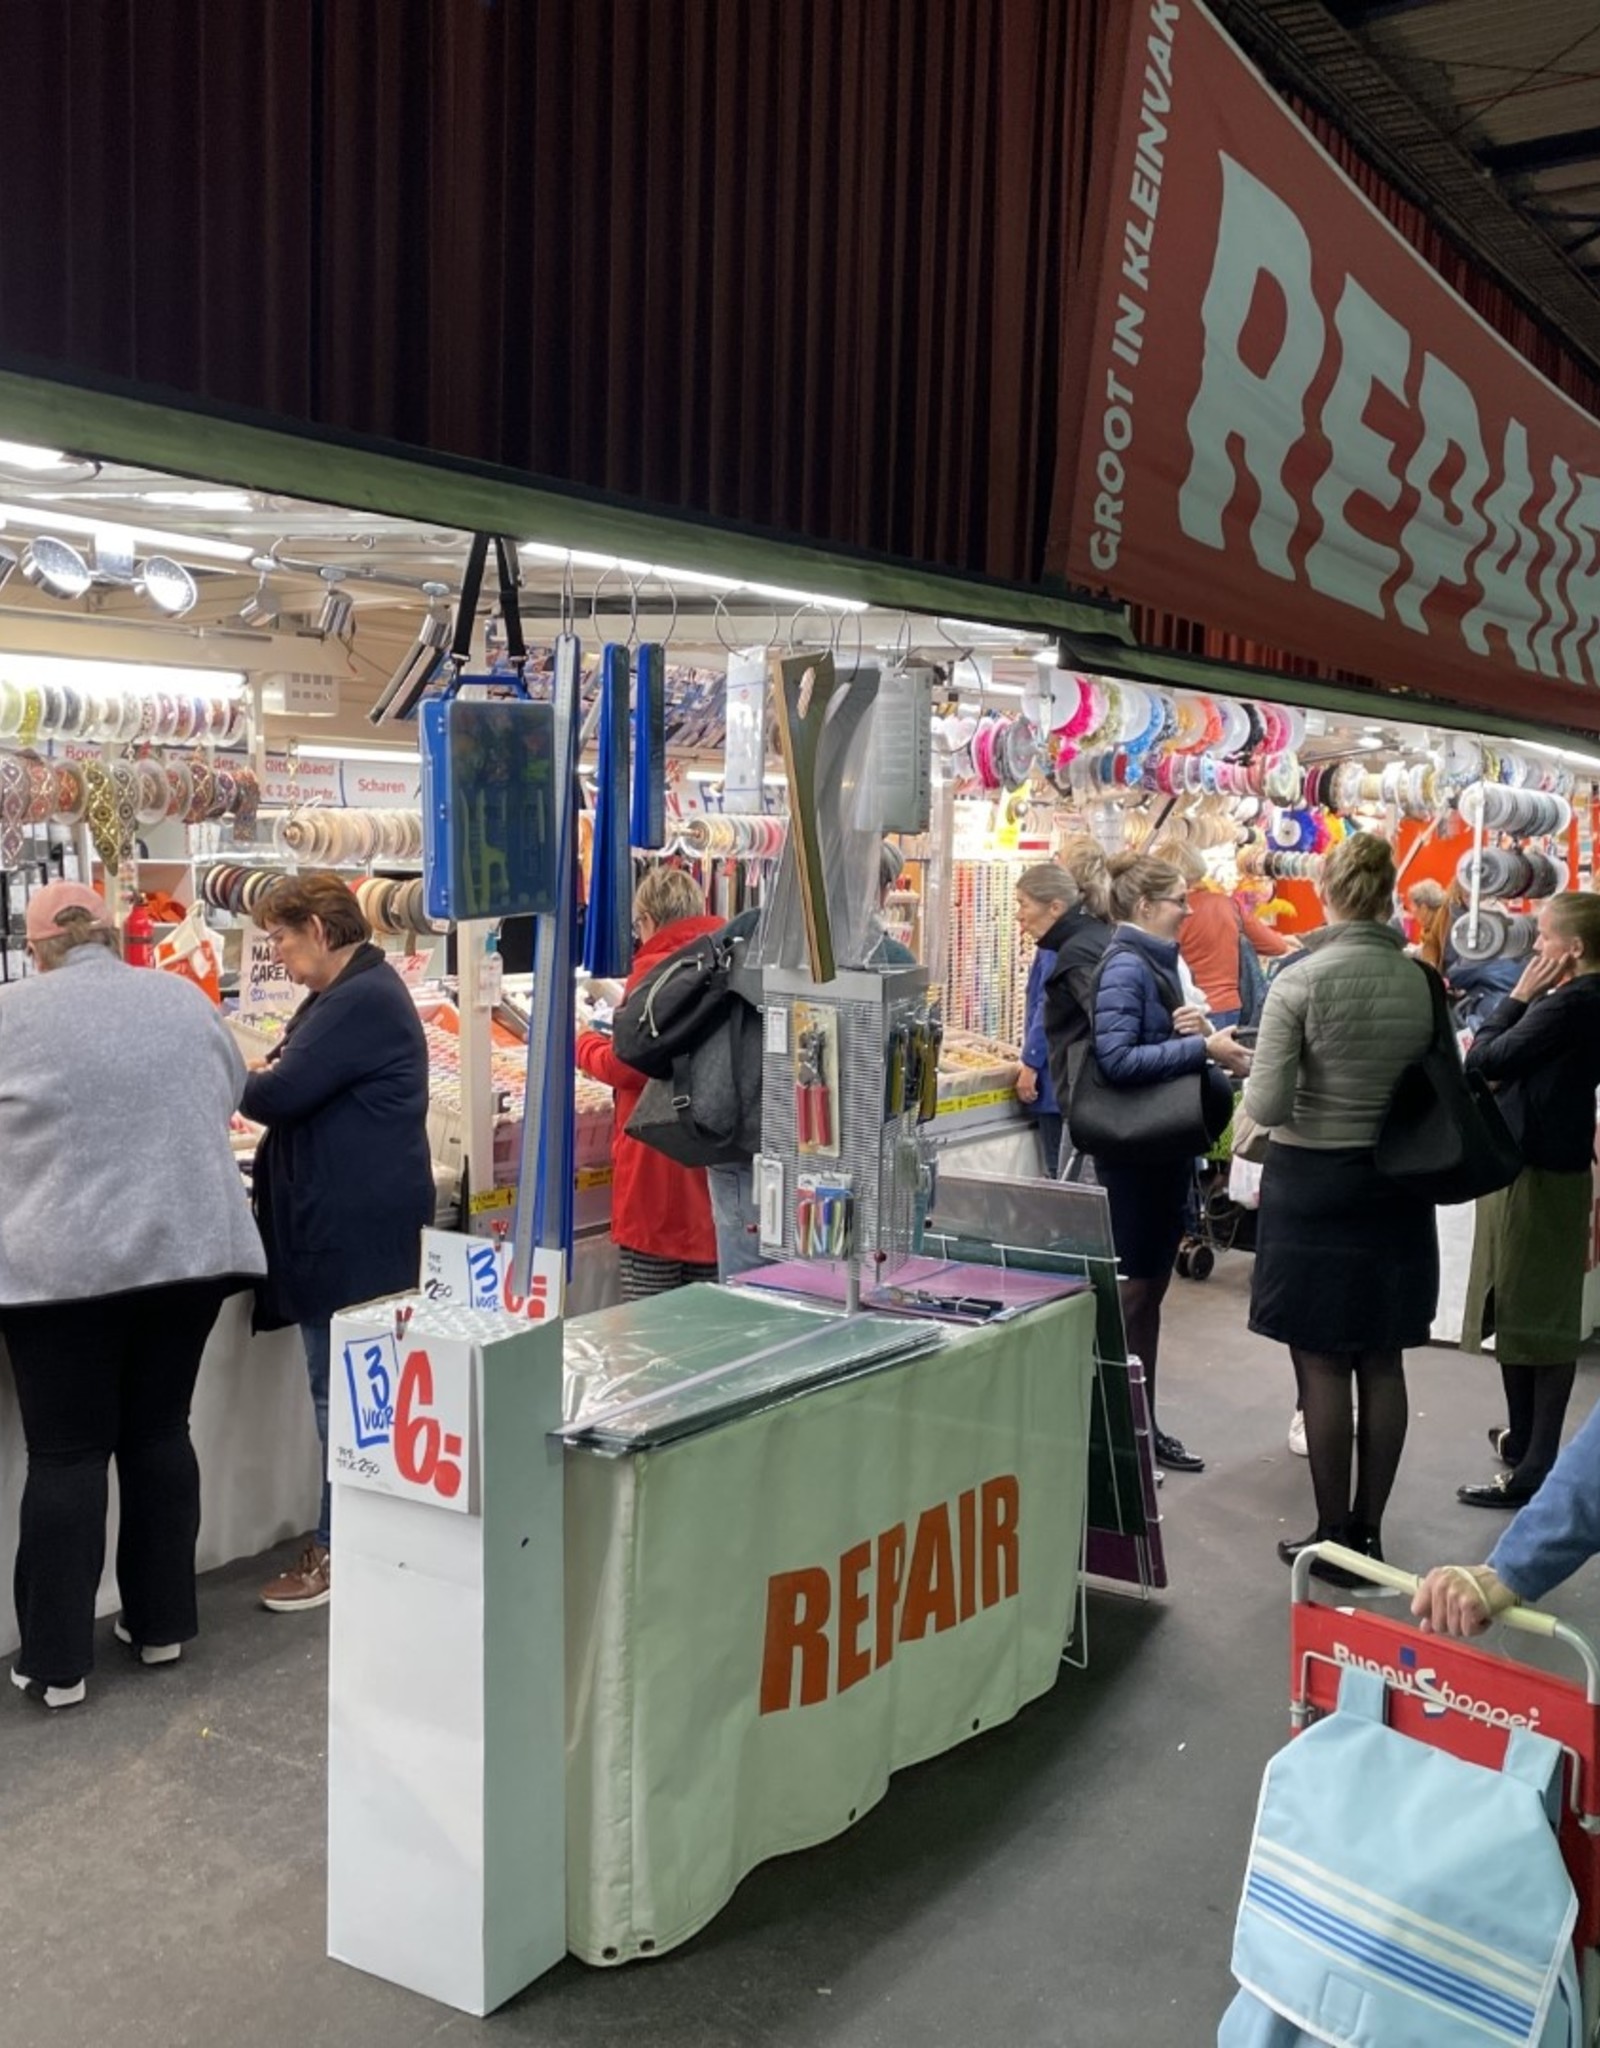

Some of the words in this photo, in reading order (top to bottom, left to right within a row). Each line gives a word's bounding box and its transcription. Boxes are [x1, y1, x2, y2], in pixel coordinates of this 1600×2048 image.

[1090, 368, 1134, 571] GROOT
[1112, 293, 1146, 367] IN
[358, 778, 406, 793] Scharen
[470, 1247, 498, 1294] 3
[364, 1344, 390, 1410] 3
[362, 1405, 395, 1431] VOOR
[760, 1474, 1019, 1717] REPAIR
